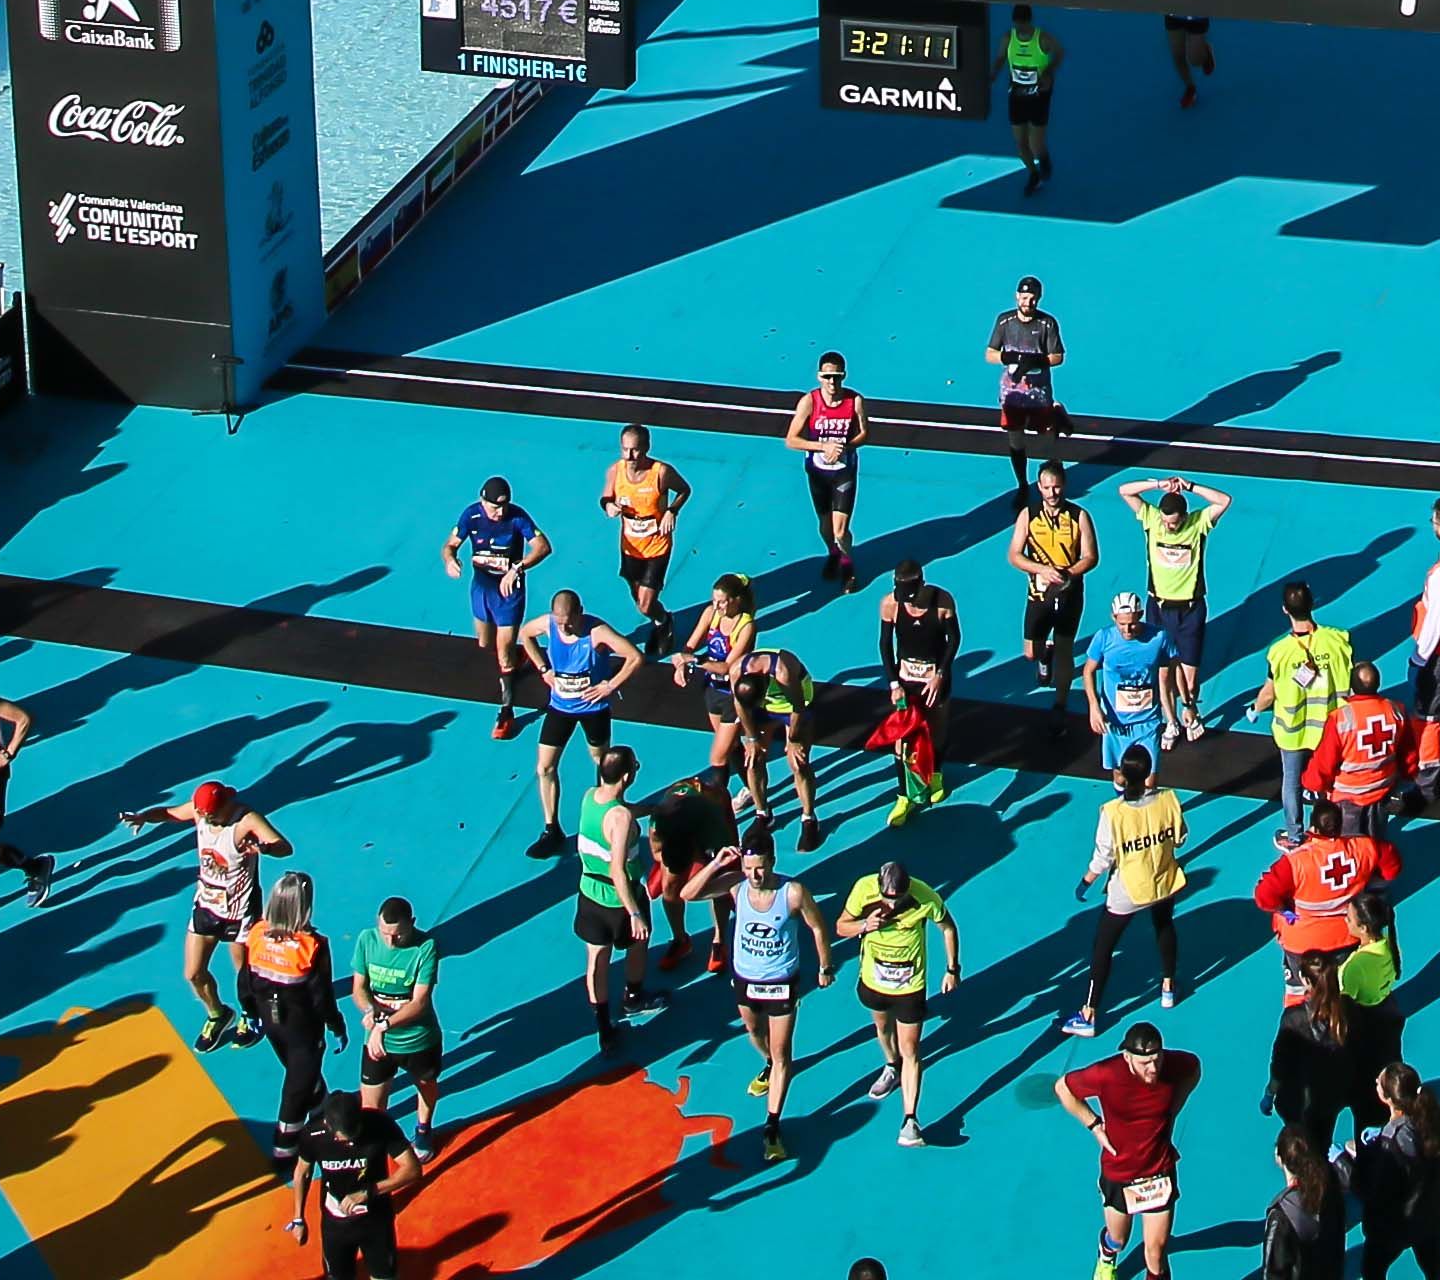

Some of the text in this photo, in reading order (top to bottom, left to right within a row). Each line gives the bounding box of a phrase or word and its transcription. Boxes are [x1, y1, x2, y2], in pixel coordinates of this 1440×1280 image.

[65, 23, 157, 52] CaixaBank
[849, 30, 951, 59] 3:21:11
[48, 93, 186, 147] Coca-Cola
[78, 191, 184, 216] Comunitat Valenciana
[77, 206, 185, 233] COMUNITAT
[85, 223, 112, 243] DE
[1121, 827, 1175, 855] MÉDICO
